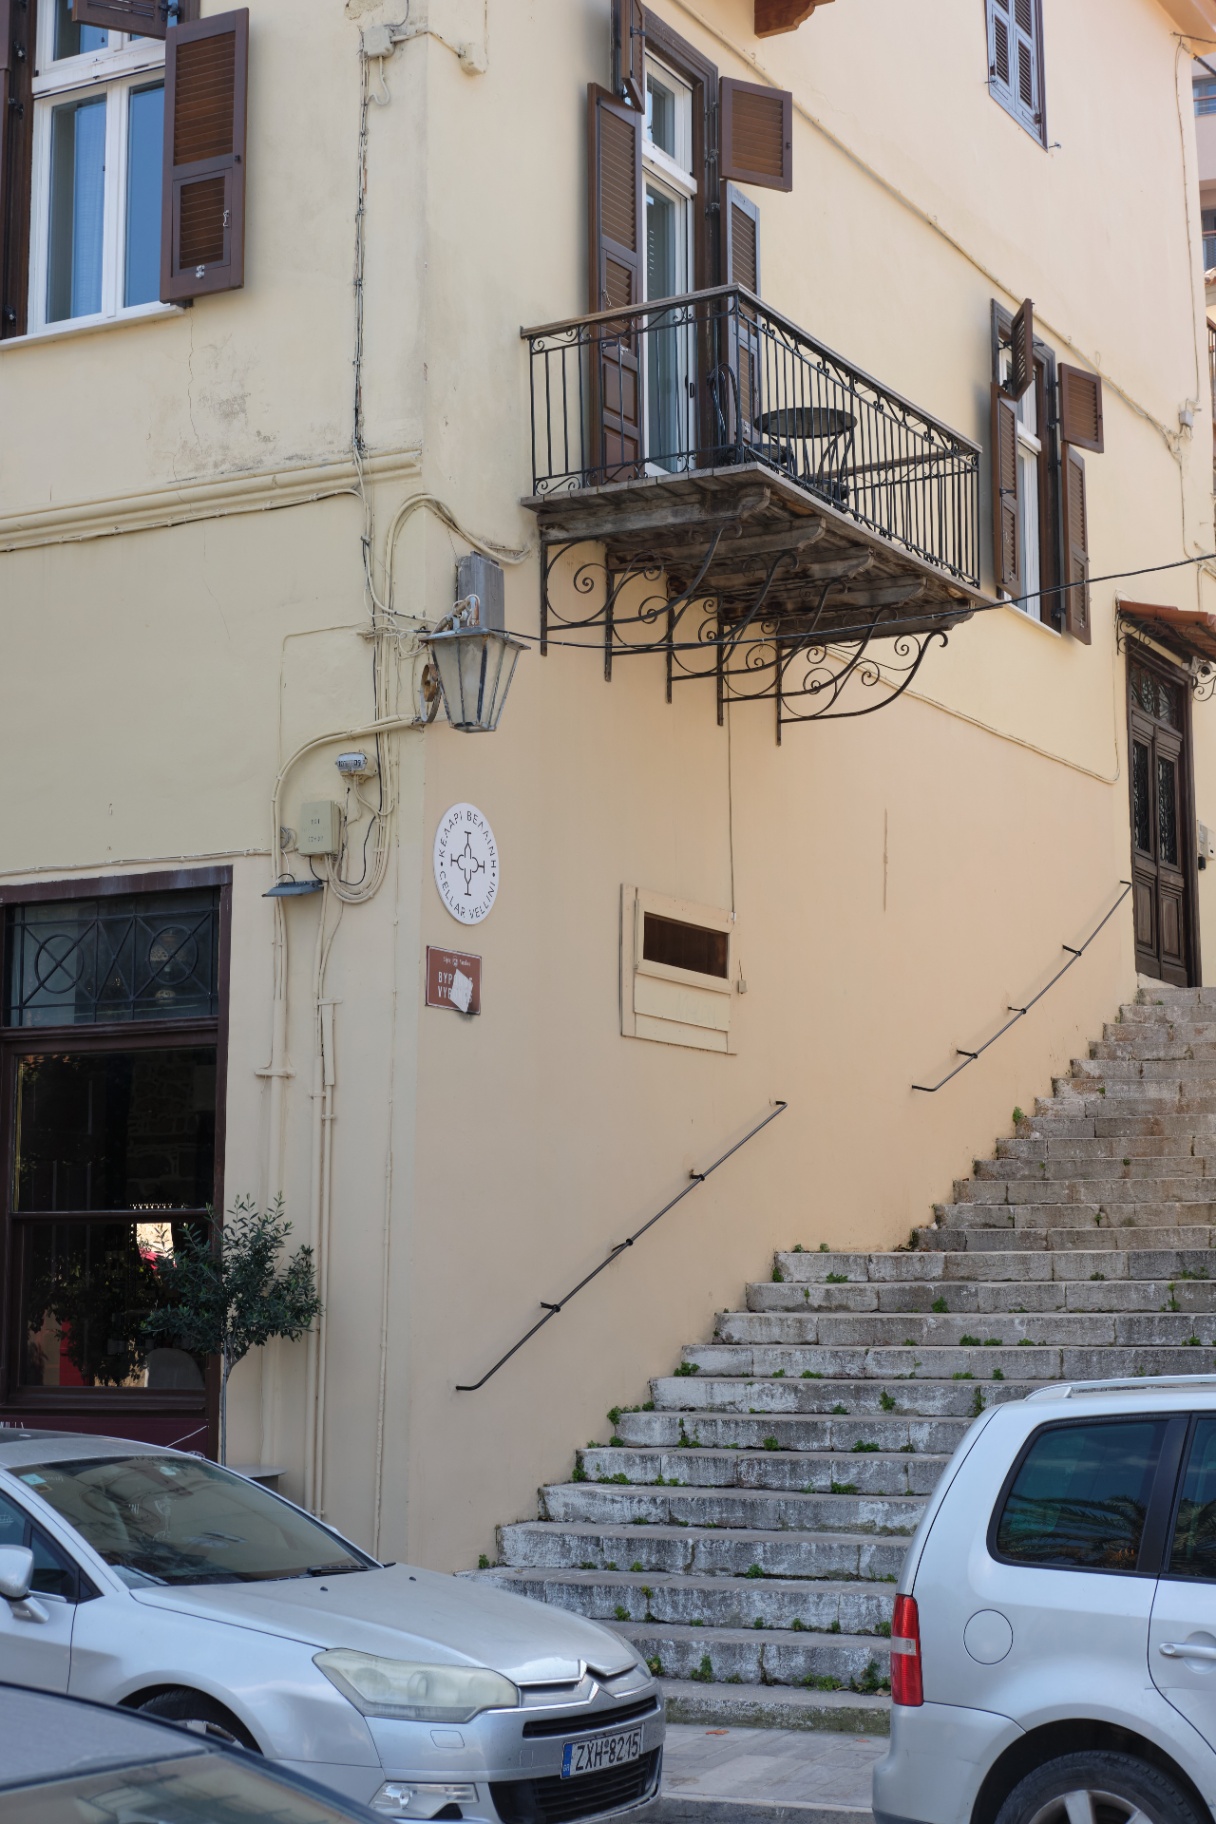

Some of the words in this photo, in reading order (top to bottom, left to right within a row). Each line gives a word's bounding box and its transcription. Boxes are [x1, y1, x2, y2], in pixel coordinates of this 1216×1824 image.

[439, 811, 463, 858] ΚΕΛΑΡΙ
[439, 870, 466, 919] CELLAR
[469, 881, 496, 919] VELLINI
[575, 1732, 639, 1771] ZXH-8215
